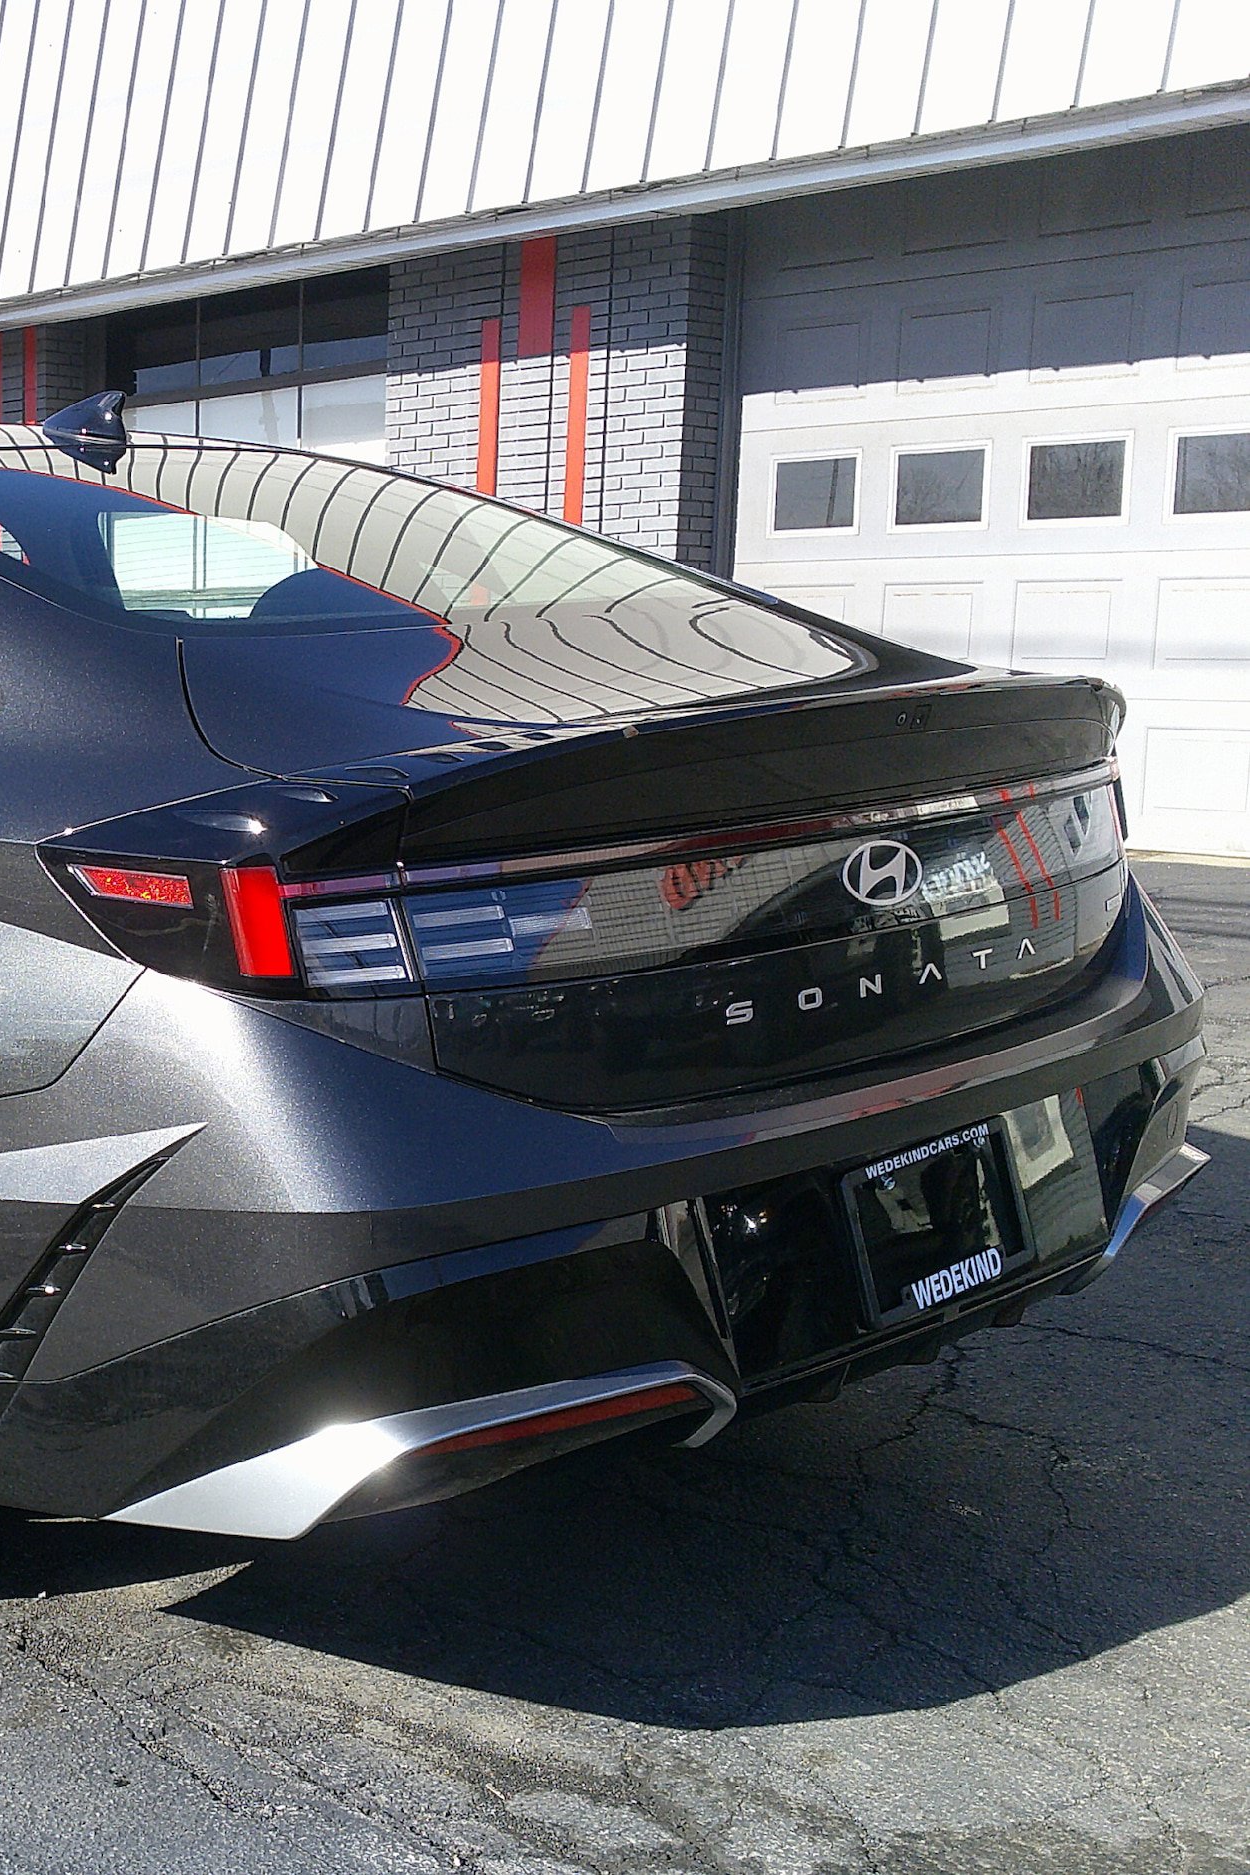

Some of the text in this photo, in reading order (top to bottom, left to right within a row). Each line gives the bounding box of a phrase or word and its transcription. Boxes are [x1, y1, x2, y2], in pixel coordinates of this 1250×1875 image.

[726, 937, 1036, 1026] SONATA
[865, 1123, 989, 1180] WEDEKINDCARS.COM
[910, 1247, 1002, 1310] WEDEKIND
